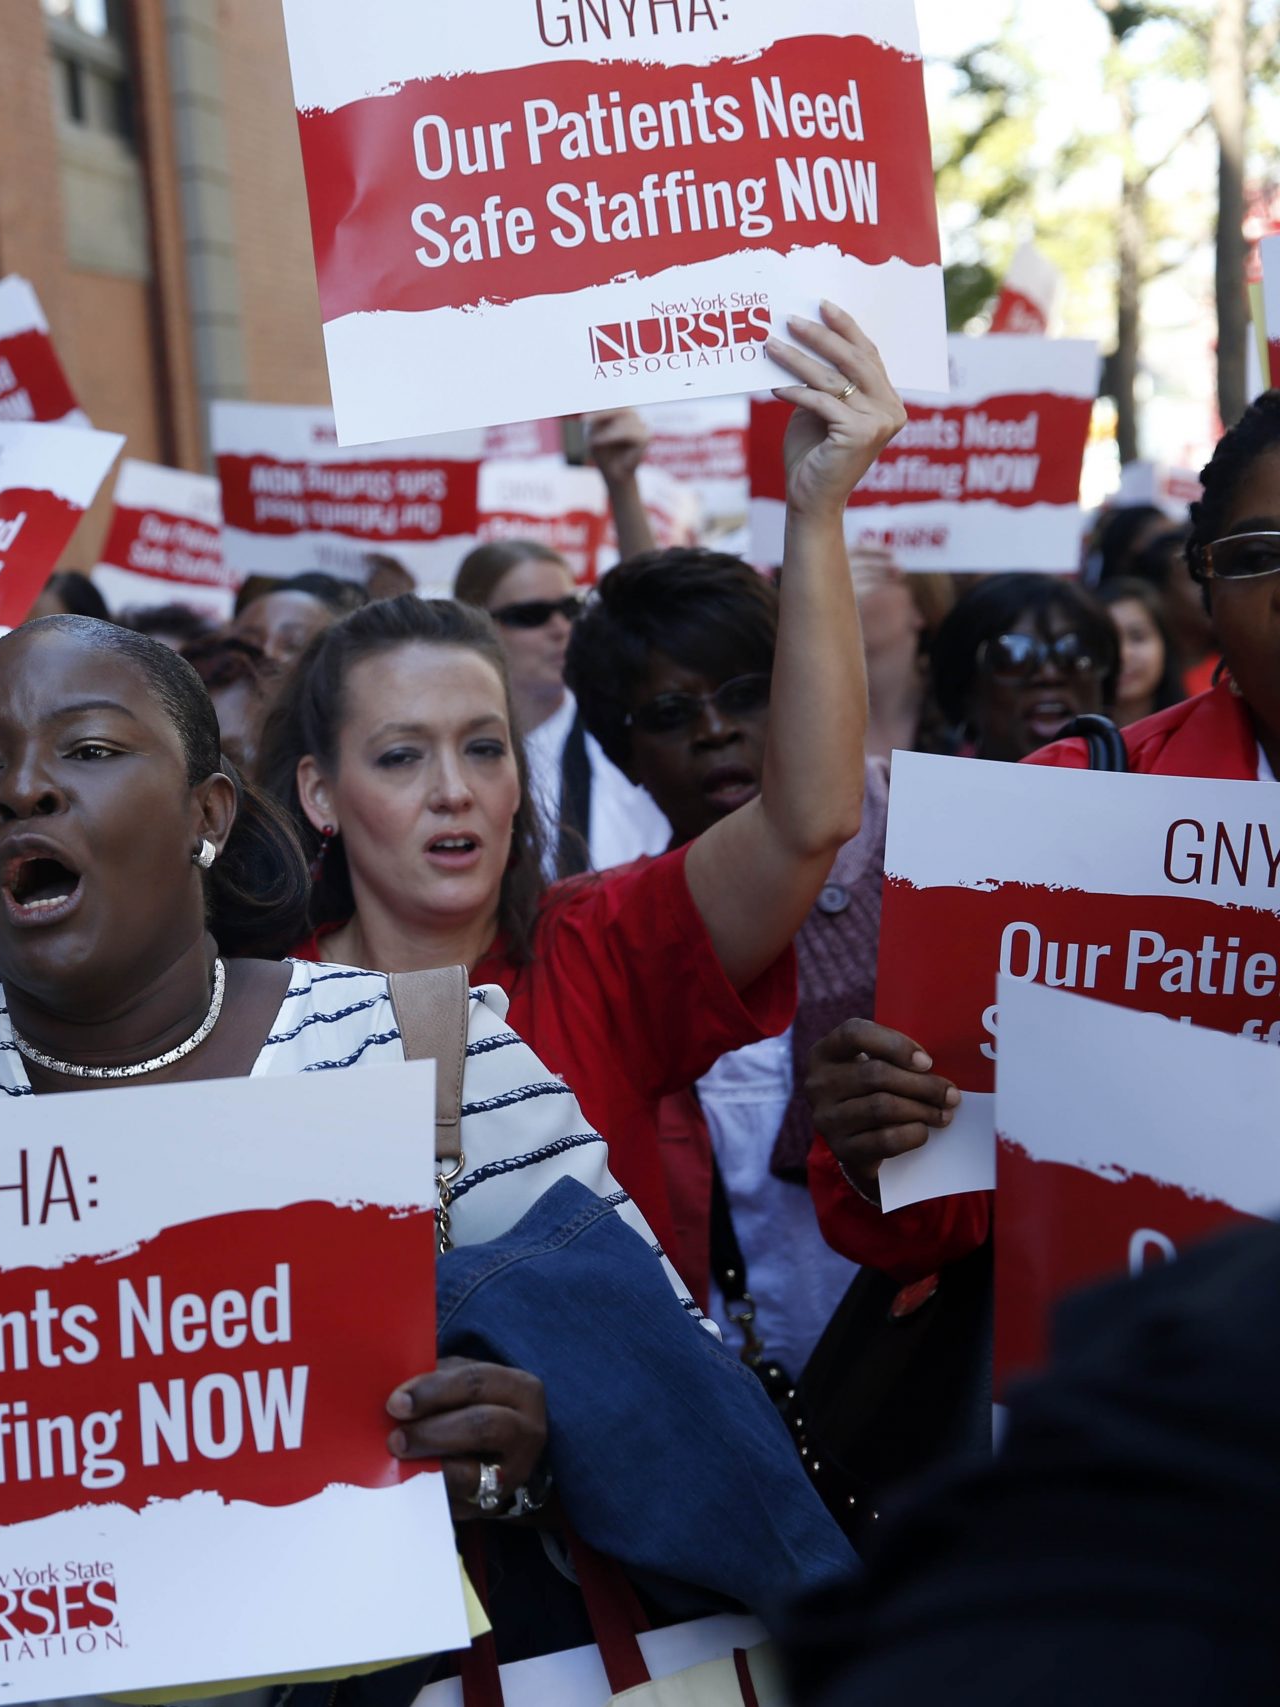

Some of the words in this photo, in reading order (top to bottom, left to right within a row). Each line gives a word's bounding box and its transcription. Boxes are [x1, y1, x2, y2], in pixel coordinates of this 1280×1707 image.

[536, 0, 729, 48] GNYHA:
[413, 114, 512, 181] Our
[524, 82, 745, 165] Patients
[751, 76, 864, 142] Need
[411, 194, 535, 268] Safe
[546, 169, 773, 249] Staffing
[776, 157, 878, 226] NOW
[651, 301, 689, 316] New
[692, 293, 727, 312] York
[730, 291, 768, 308] State
[588, 306, 773, 364] NURSES
[594, 341, 768, 380] ASSOCIATIO
[962, 410, 1039, 450] Need
[854, 453, 965, 499] taffing
[966, 453, 1040, 493] NOW
[998, 921, 1111, 989] Our
[1124, 929, 1278, 997] Patie
[118, 1262, 293, 1360] Need
[138, 1364, 309, 1467] NOW
[13, 1562, 61, 1587] York
[64, 1560, 114, 1581] State
